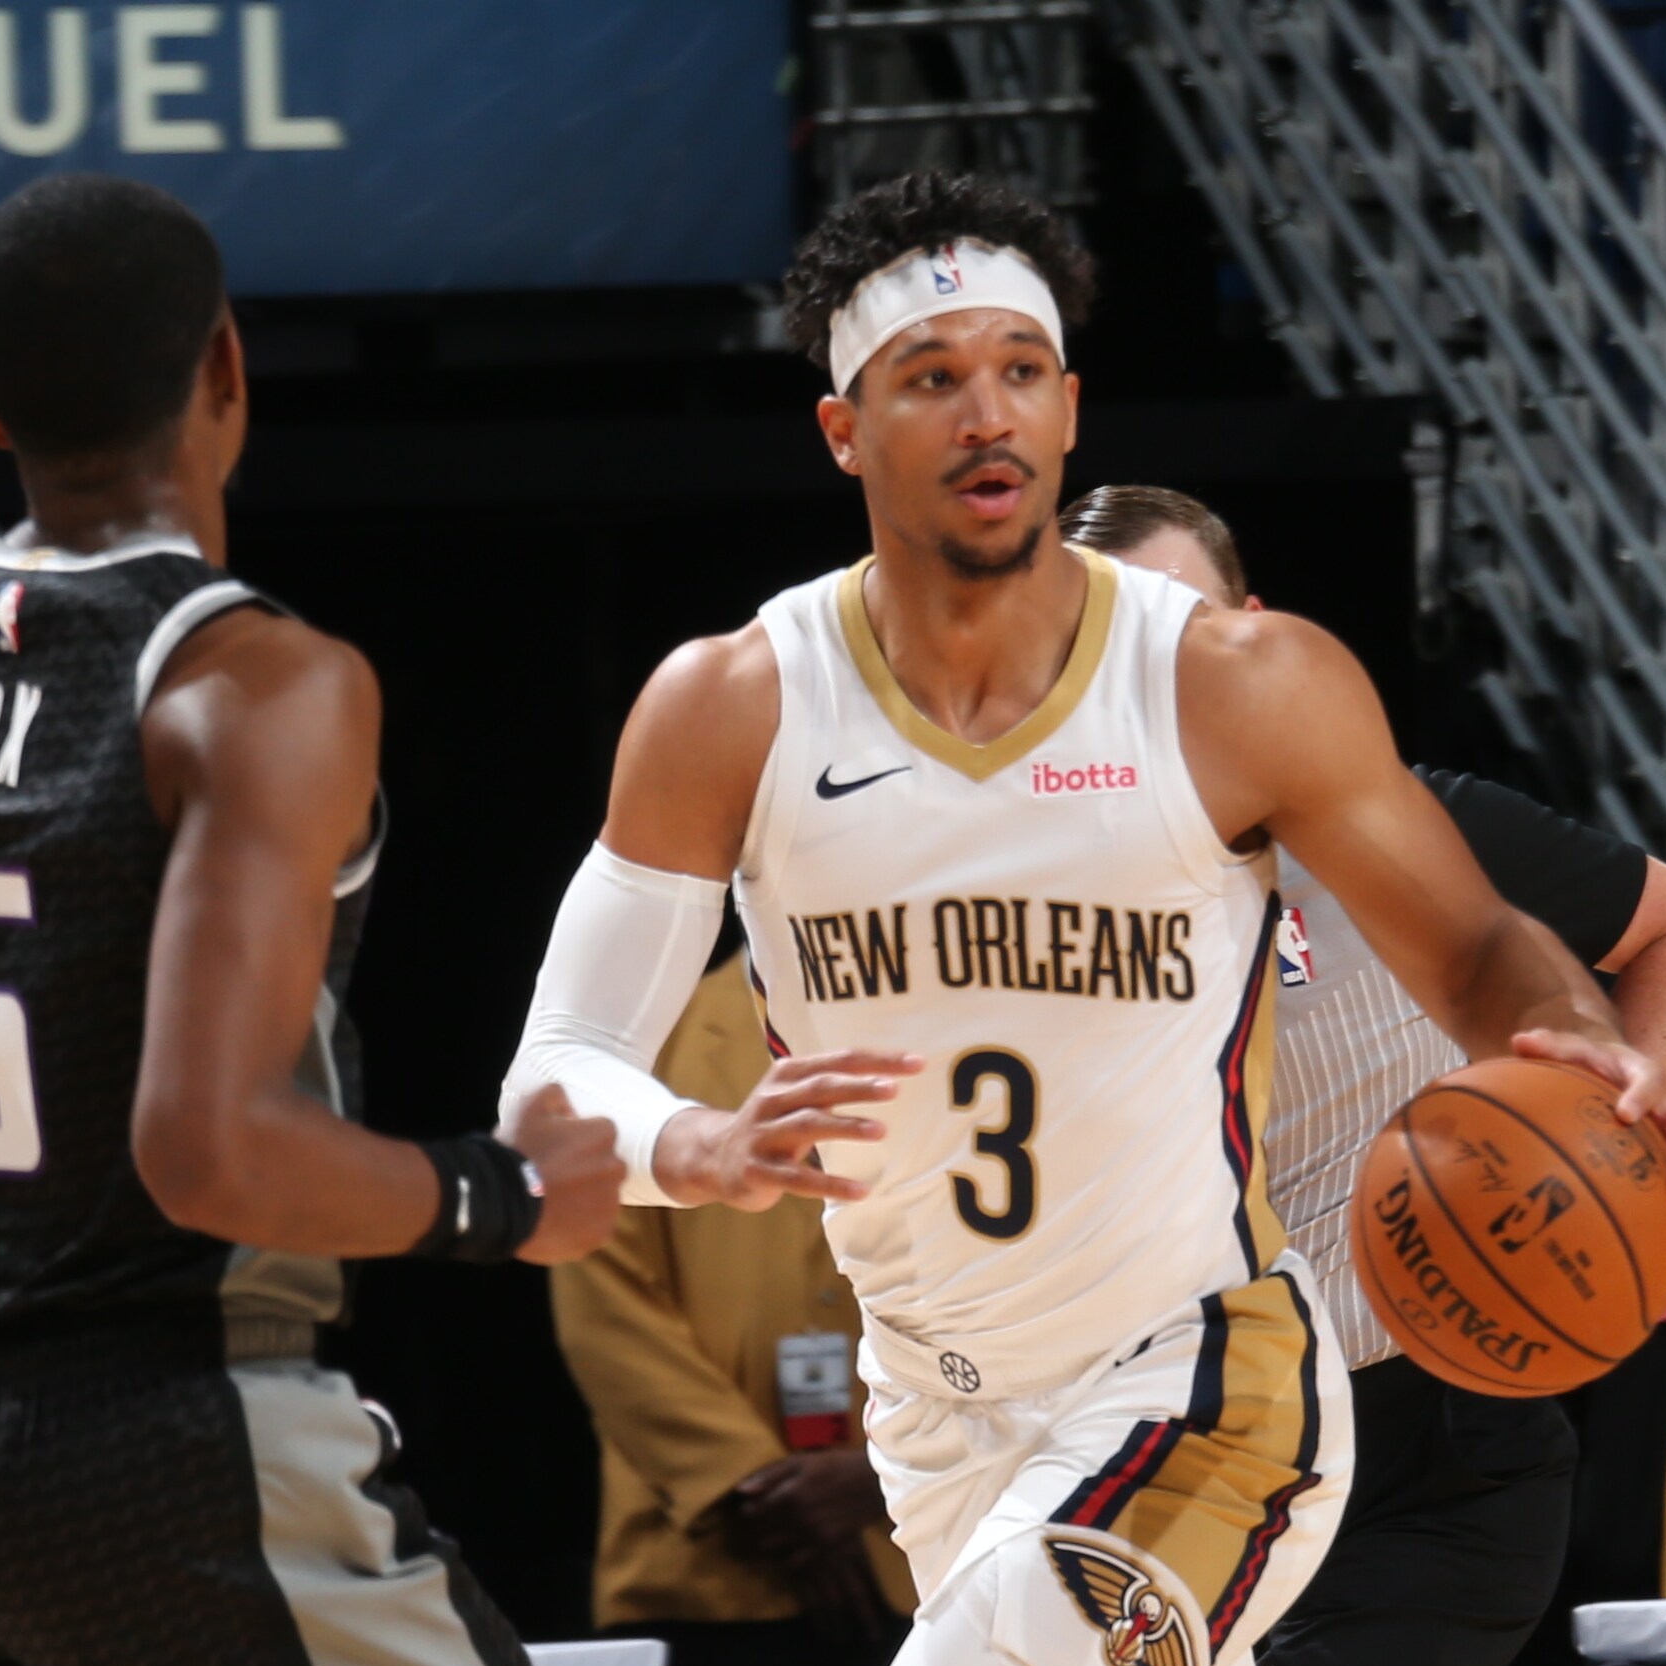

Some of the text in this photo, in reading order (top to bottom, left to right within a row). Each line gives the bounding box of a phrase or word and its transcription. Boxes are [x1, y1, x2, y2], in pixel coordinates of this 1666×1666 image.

[1031, 761, 1137, 796] ibotta
[788, 896, 1196, 1003] NEW ORLEANS
[949, 1044, 1039, 1243] 3
[1373, 1177, 1551, 1373] SPALDING
